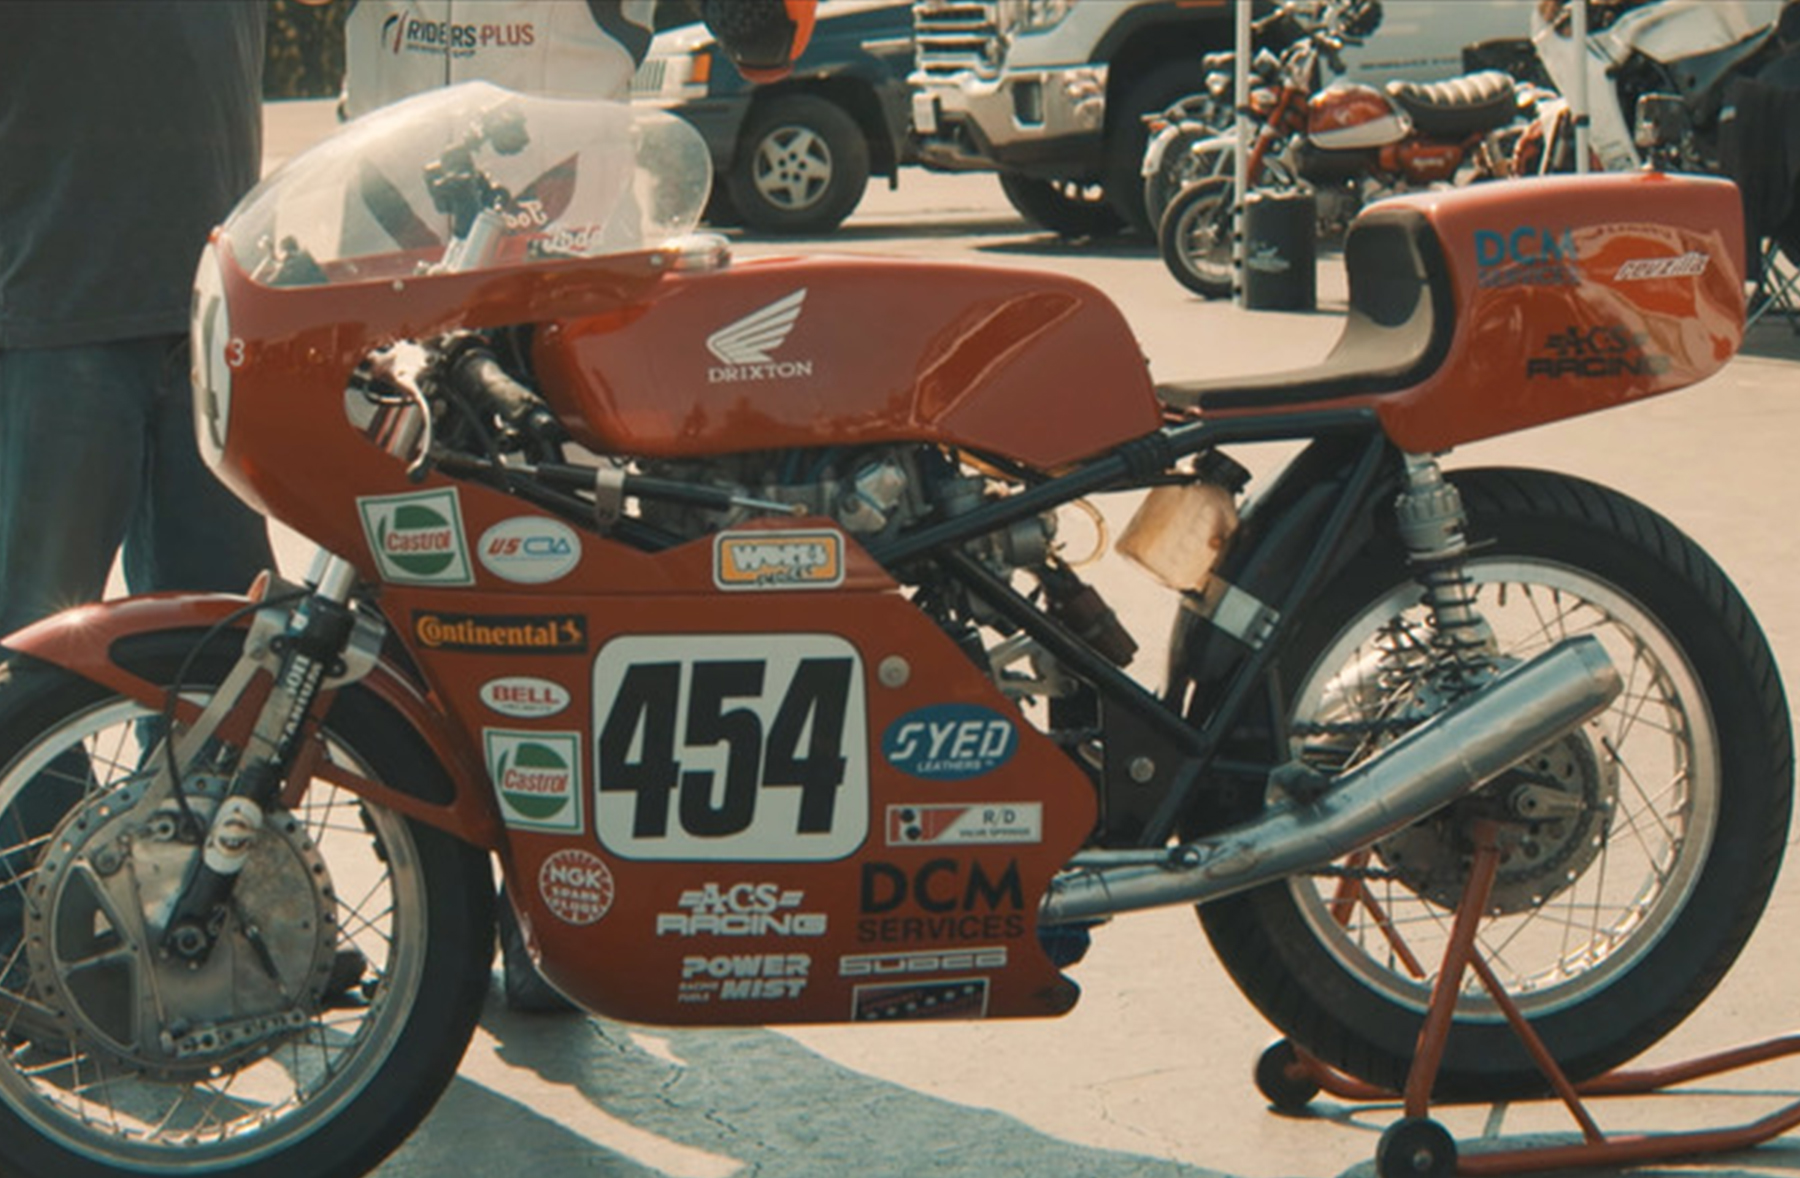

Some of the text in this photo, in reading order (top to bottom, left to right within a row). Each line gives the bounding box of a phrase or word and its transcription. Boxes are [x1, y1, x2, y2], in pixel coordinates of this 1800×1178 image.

[407, 19, 535, 47] RIDERS PLUS
[1473, 226, 1577, 267] DCM
[708, 361, 813, 382] DRIXTON
[387, 530, 452, 552] Castrol
[417, 616, 557, 646] Continental
[493, 685, 561, 705] BELL
[270, 661, 324, 764] TTANIUM
[599, 658, 853, 839] 454
[889, 720, 1011, 761] SYED
[917, 759, 981, 773] LEATHERS
[504, 768, 568, 793] Castrol
[549, 863, 602, 889] NGK
[860, 857, 1024, 914] DCM
[692, 882, 779, 914] ACS
[656, 913, 828, 936] RACING
[857, 914, 1026, 944] SERVICES
[682, 953, 812, 979] POWER
[720, 979, 807, 1000] MIST
